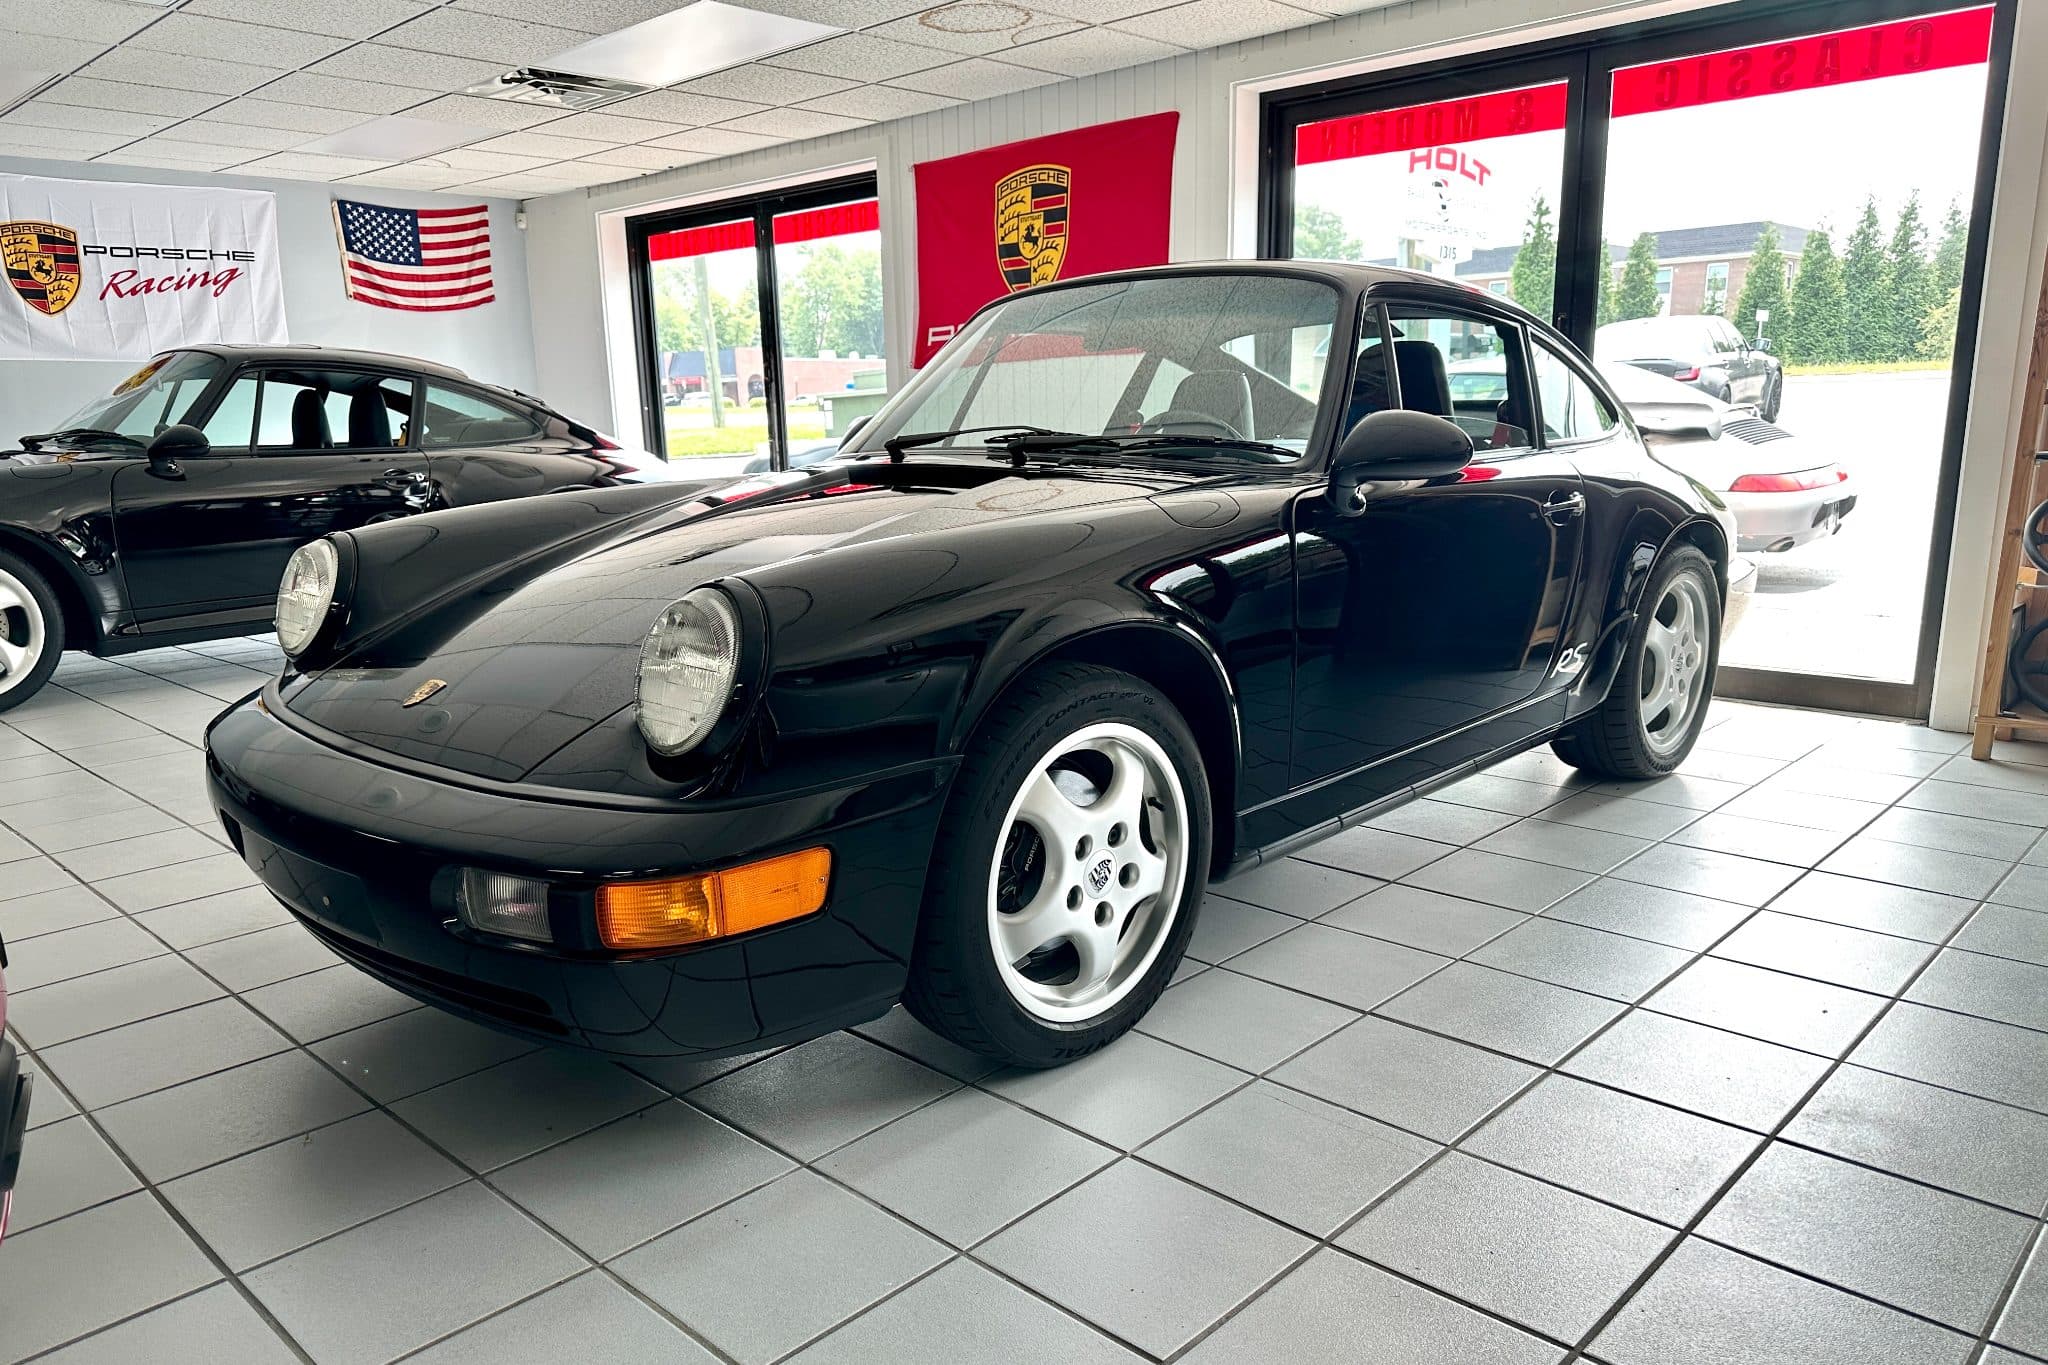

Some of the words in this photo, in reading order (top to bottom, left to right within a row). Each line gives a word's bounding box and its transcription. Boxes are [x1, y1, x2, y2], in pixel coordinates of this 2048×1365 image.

[1409, 147, 1491, 186] HOLT
[1000, 171, 1066, 197] PORSCHE
[1, 225, 72, 239] PORSCHE
[83, 244, 255, 262] PORSCHE
[99, 267, 244, 301] Racing
